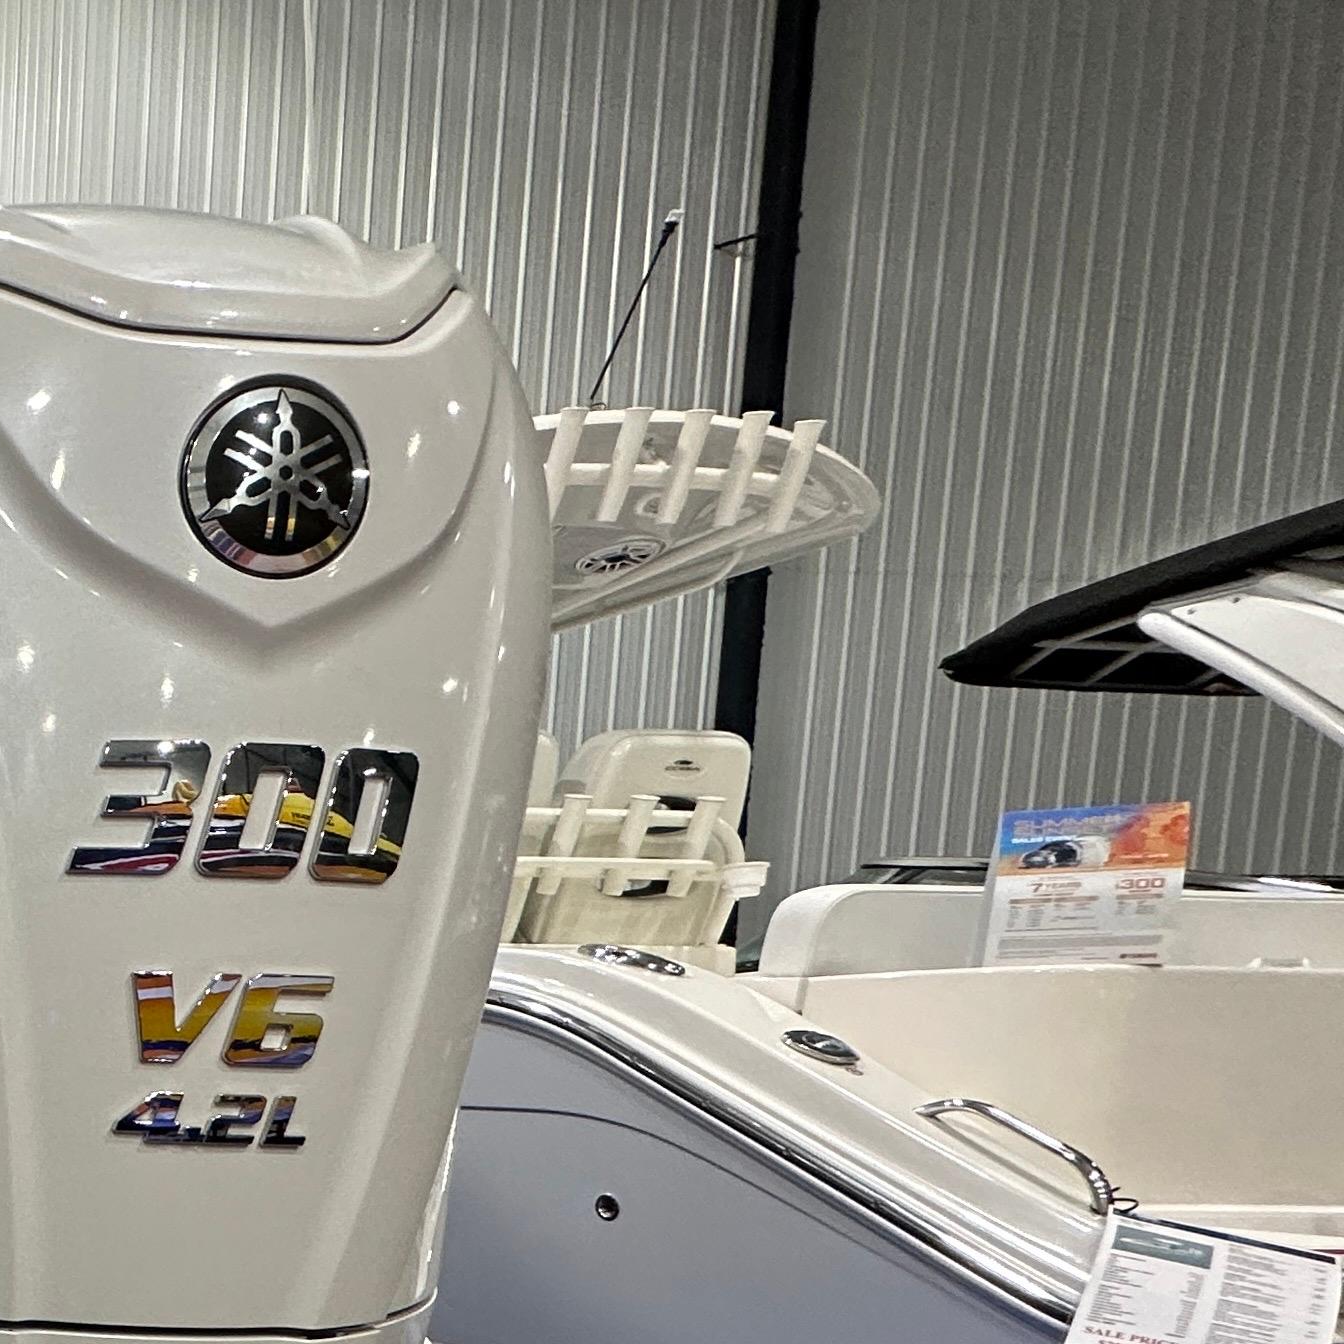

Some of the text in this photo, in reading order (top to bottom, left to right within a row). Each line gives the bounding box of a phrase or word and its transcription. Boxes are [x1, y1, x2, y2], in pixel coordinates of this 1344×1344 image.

[65, 739, 420, 884] 300
[129, 969, 336, 1069] V6
[112, 1090, 306, 1149] 4.2L
[1082, 1326, 1126, 1340] SALE
